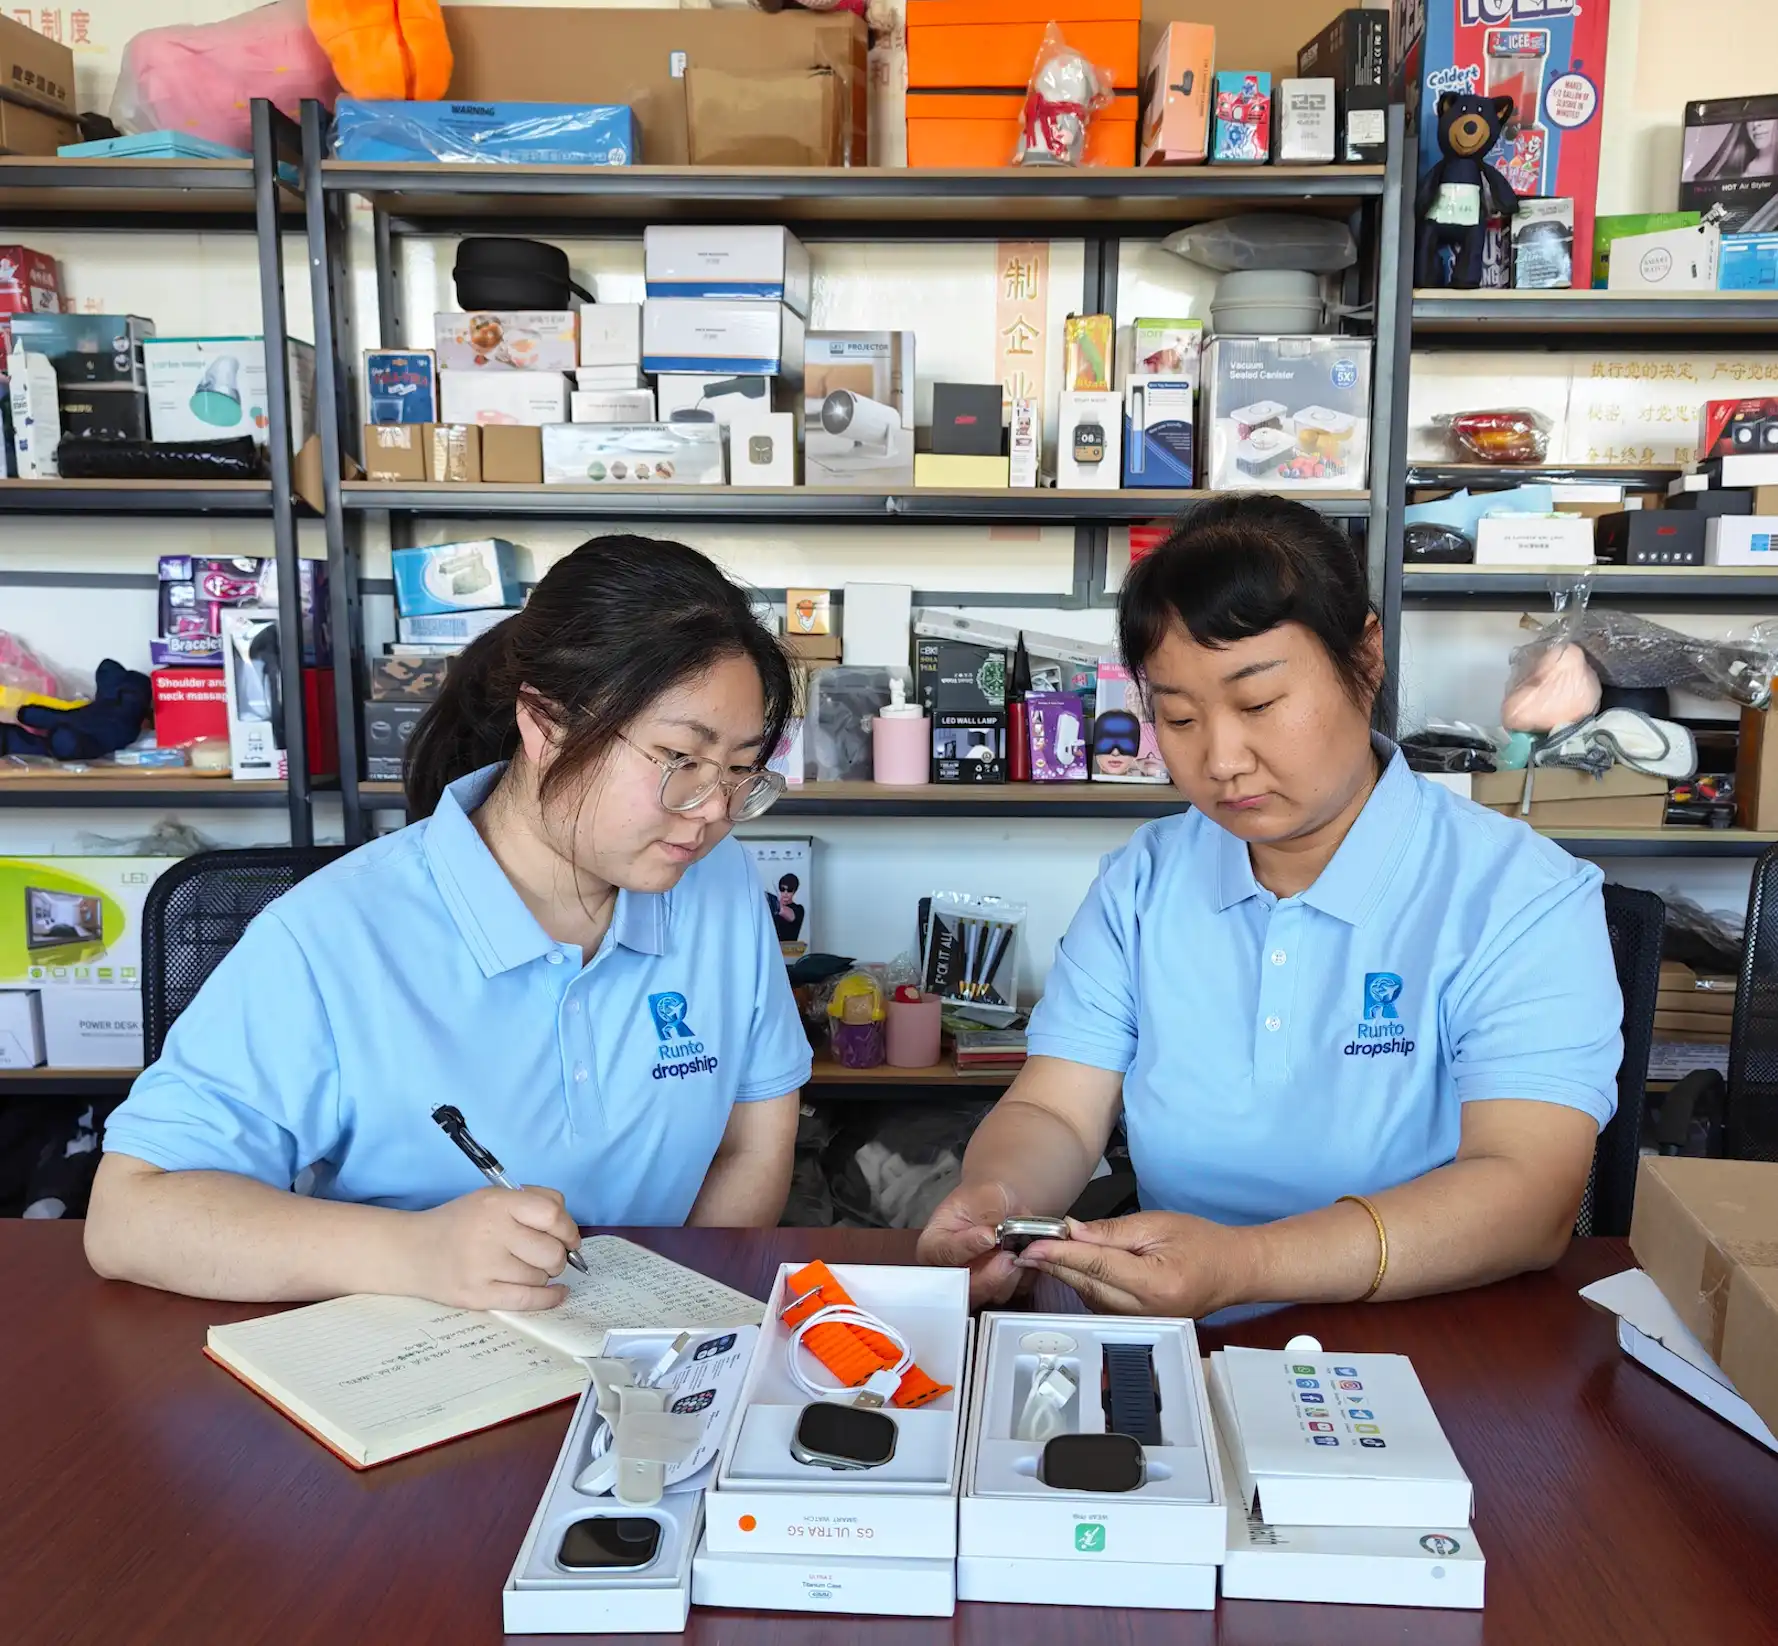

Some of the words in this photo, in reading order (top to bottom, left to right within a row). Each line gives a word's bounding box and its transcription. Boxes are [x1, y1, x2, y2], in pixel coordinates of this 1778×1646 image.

[1508, 33, 1531, 50] ICEE
[1428, 66, 1479, 86] Coldest
[451, 104, 496, 117] WARNING
[1721, 182, 1738, 192] HOT
[1739, 181, 1749, 191] Air
[1750, 179, 1772, 191] Styler
[847, 343, 889, 351] PROJECTOR
[1230, 361, 1264, 370] Vacuum
[1229, 370, 1258, 380] Sealed
[1259, 370, 1295, 380] Canister
[157, 678, 206, 688] Shoulder
[158, 691, 185, 701] neck
[187, 692, 228, 703] massag
[941, 716, 956, 725] LED
[956, 716, 976, 725] WALL
[977, 716, 998, 725] LAMP
[121, 872, 148, 884] LED
[79, 1020, 112, 1030] POWER
[114, 1020, 139, 1030] DESK
[1357, 1021, 1405, 1039] Runto
[658, 1040, 705, 1061] Runto
[1343, 1037, 1415, 1058] dropship
[652, 1055, 718, 1080] dropship
[787, 1525, 804, 1537] 5G
[807, 1525, 850, 1538] ULTRA
